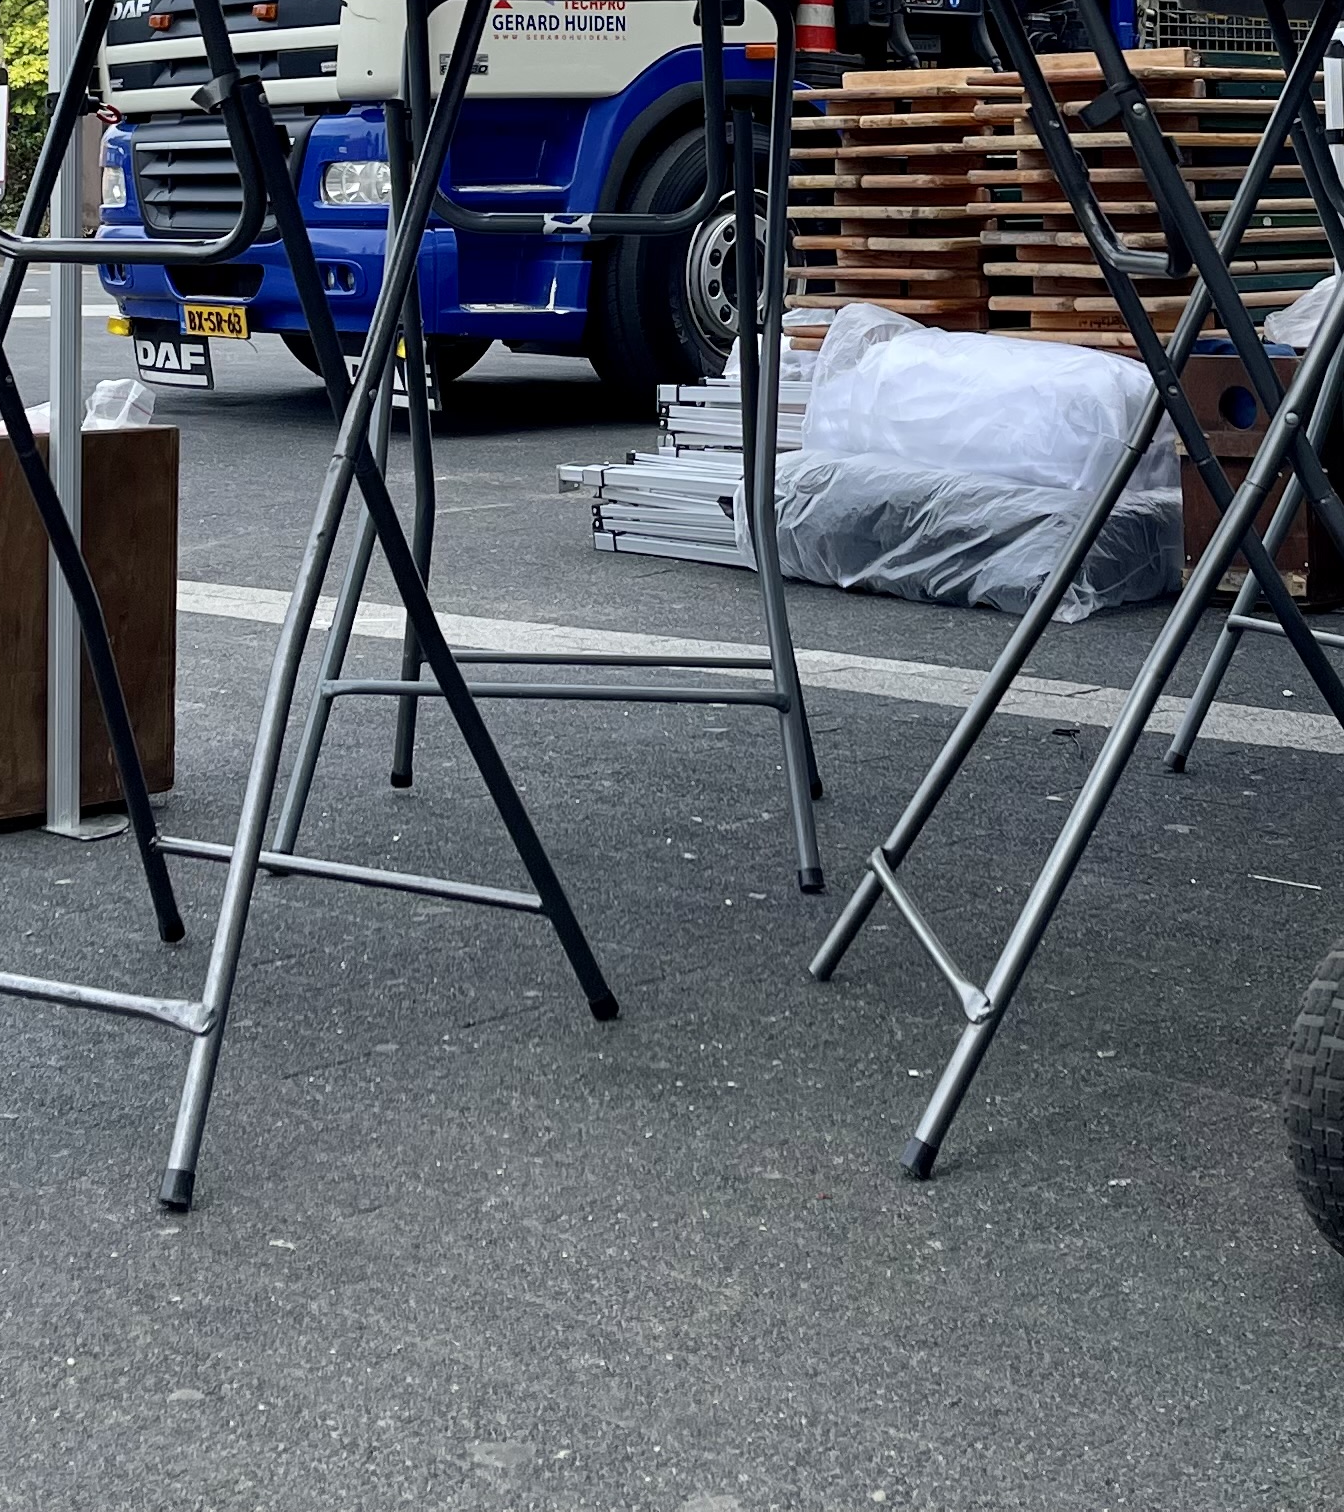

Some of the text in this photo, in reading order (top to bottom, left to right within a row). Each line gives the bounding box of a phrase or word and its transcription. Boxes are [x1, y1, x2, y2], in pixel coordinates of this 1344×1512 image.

[492, 14, 626, 31] GERARD HUIDEN
[187, 309, 243, 334] BX-SR-63
[137, 339, 206, 370] DAF
